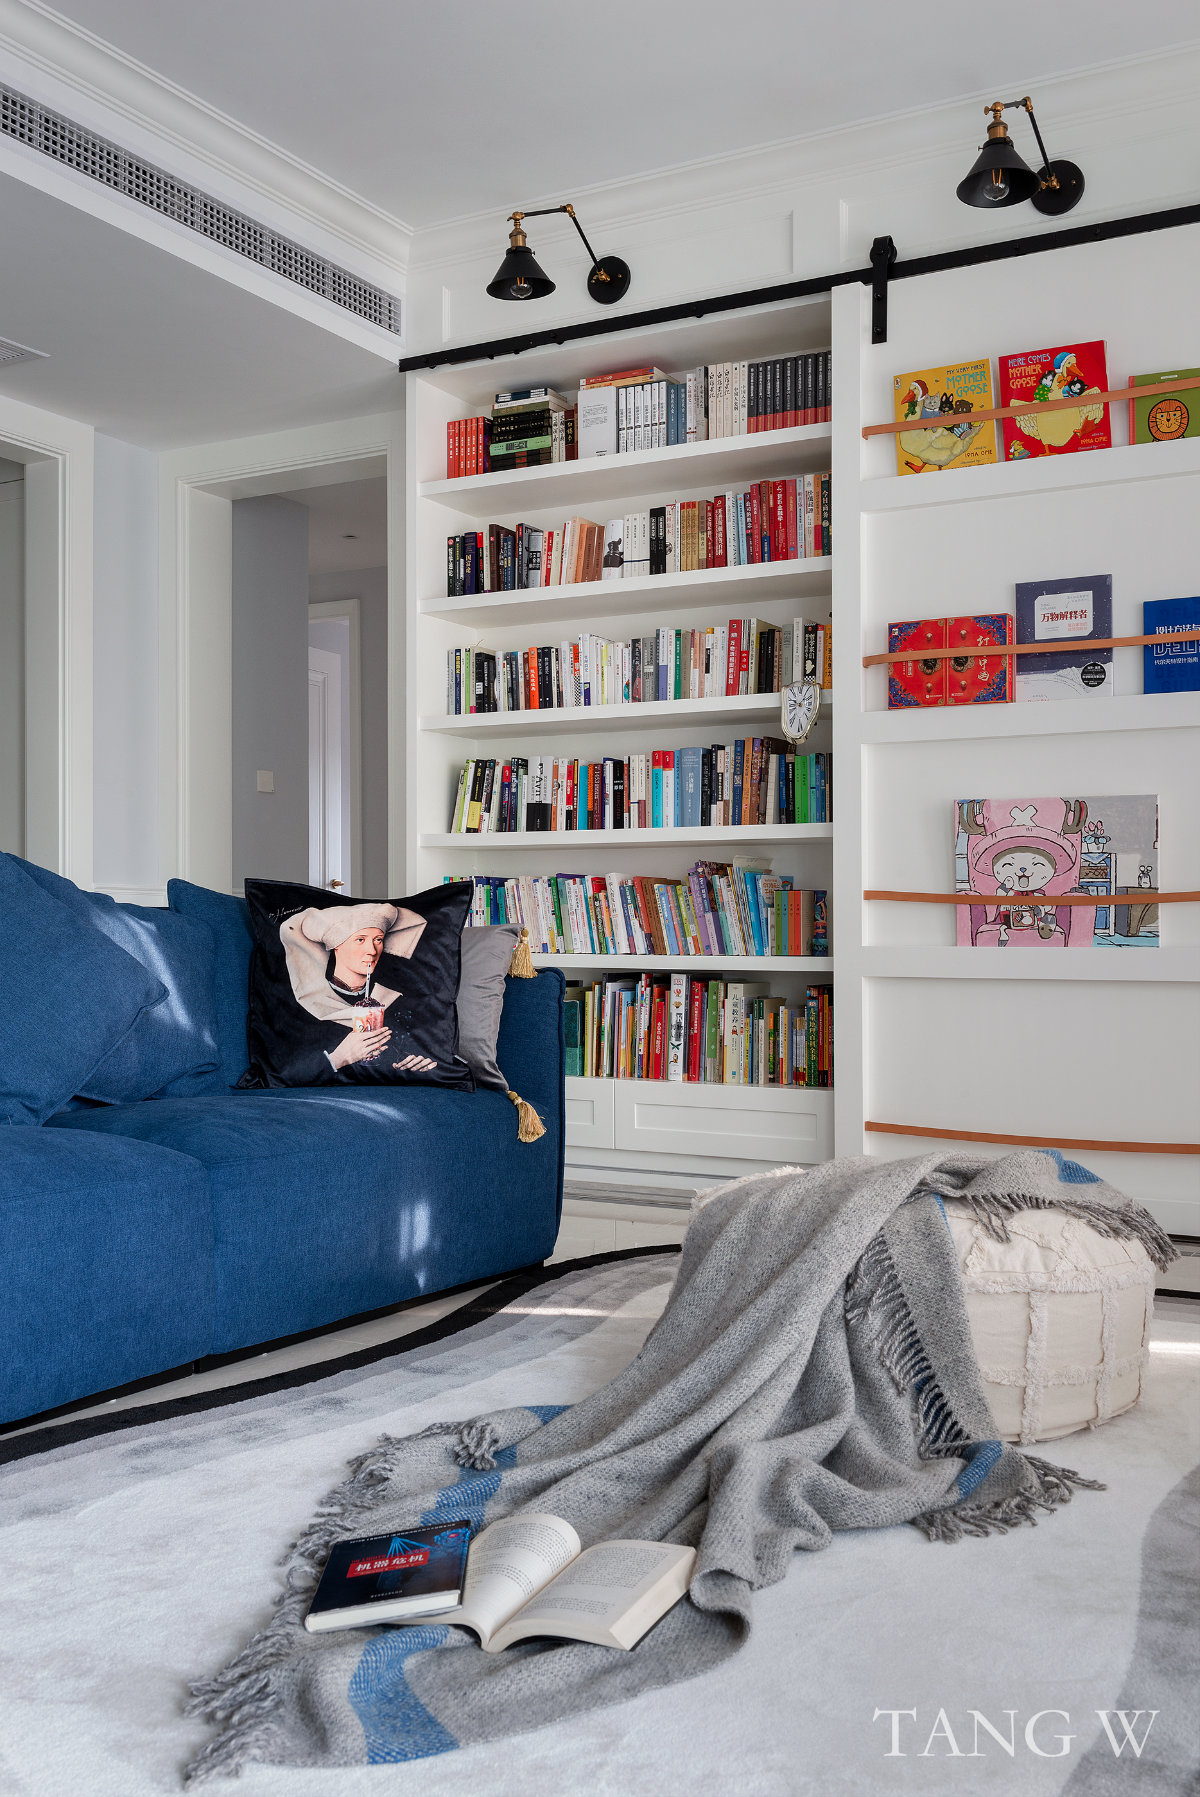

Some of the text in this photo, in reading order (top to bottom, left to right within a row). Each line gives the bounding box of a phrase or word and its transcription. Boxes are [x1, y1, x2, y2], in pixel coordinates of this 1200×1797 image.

[1008, 353, 1051, 368] HERE COMES
[1008, 363, 1042, 379] MOTHER
[946, 370, 987, 390] MOTHER
[1009, 376, 1037, 389] GOOSE
[956, 383, 988, 398] GOOSE
[1040, 609, 1088, 623] 万物解释者
[976, 635, 990, 682] 打中国
[730, 993, 739, 1024] 儿童教养
[355, 1553, 424, 1572] 机器危机
